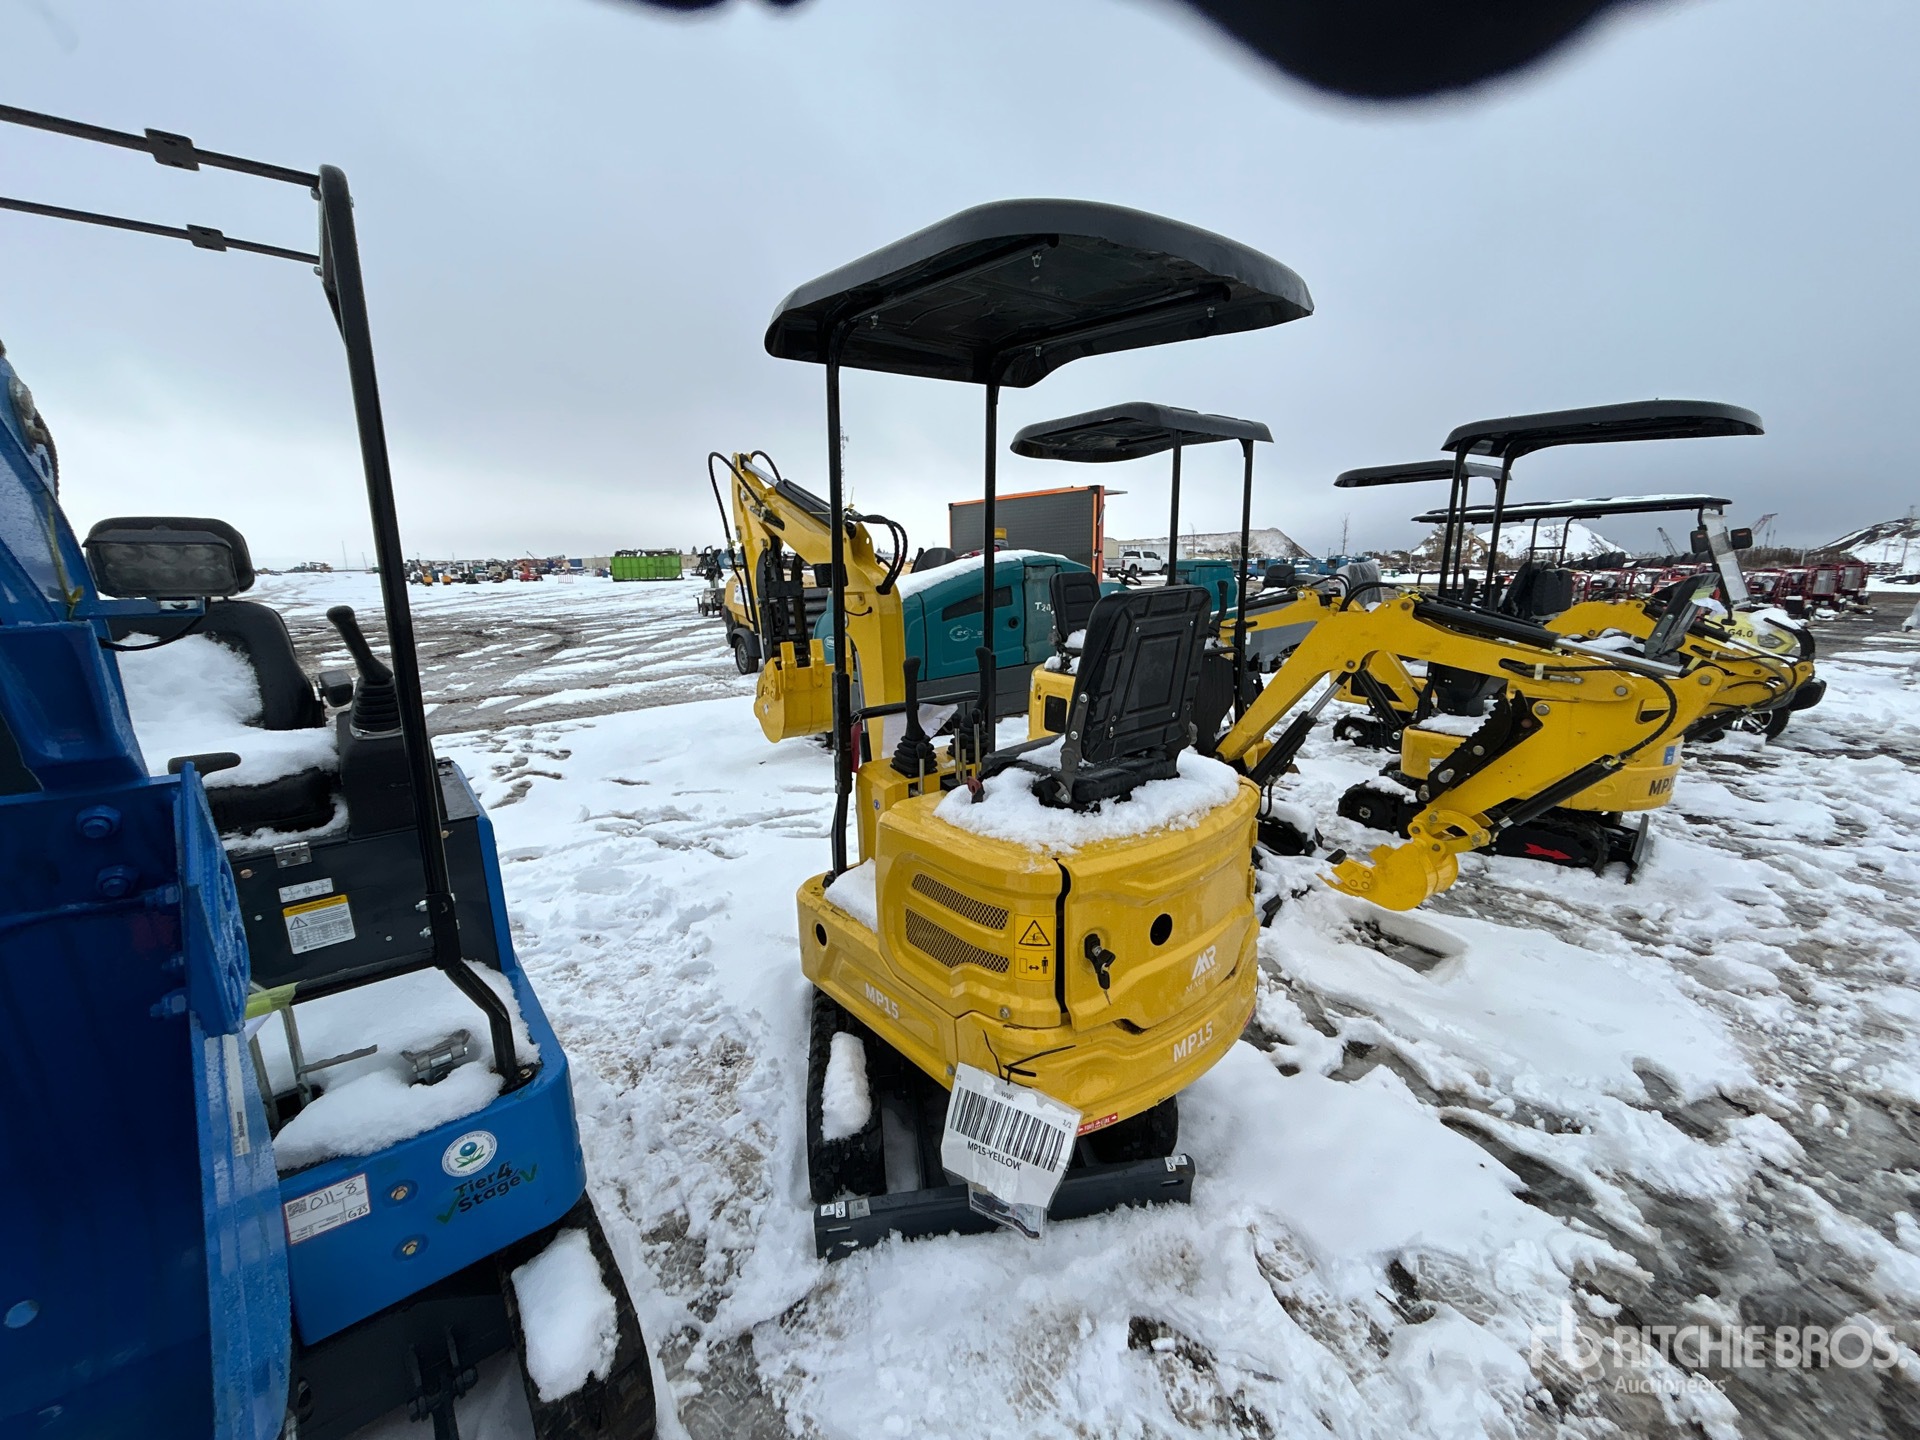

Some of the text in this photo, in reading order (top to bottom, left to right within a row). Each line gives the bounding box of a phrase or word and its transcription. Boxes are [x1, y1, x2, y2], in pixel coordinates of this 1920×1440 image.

[865, 981, 899, 1020] MP15
[1173, 1021, 1214, 1063] MP15
[967, 1140, 1022, 1171] MP15-YELLOW
